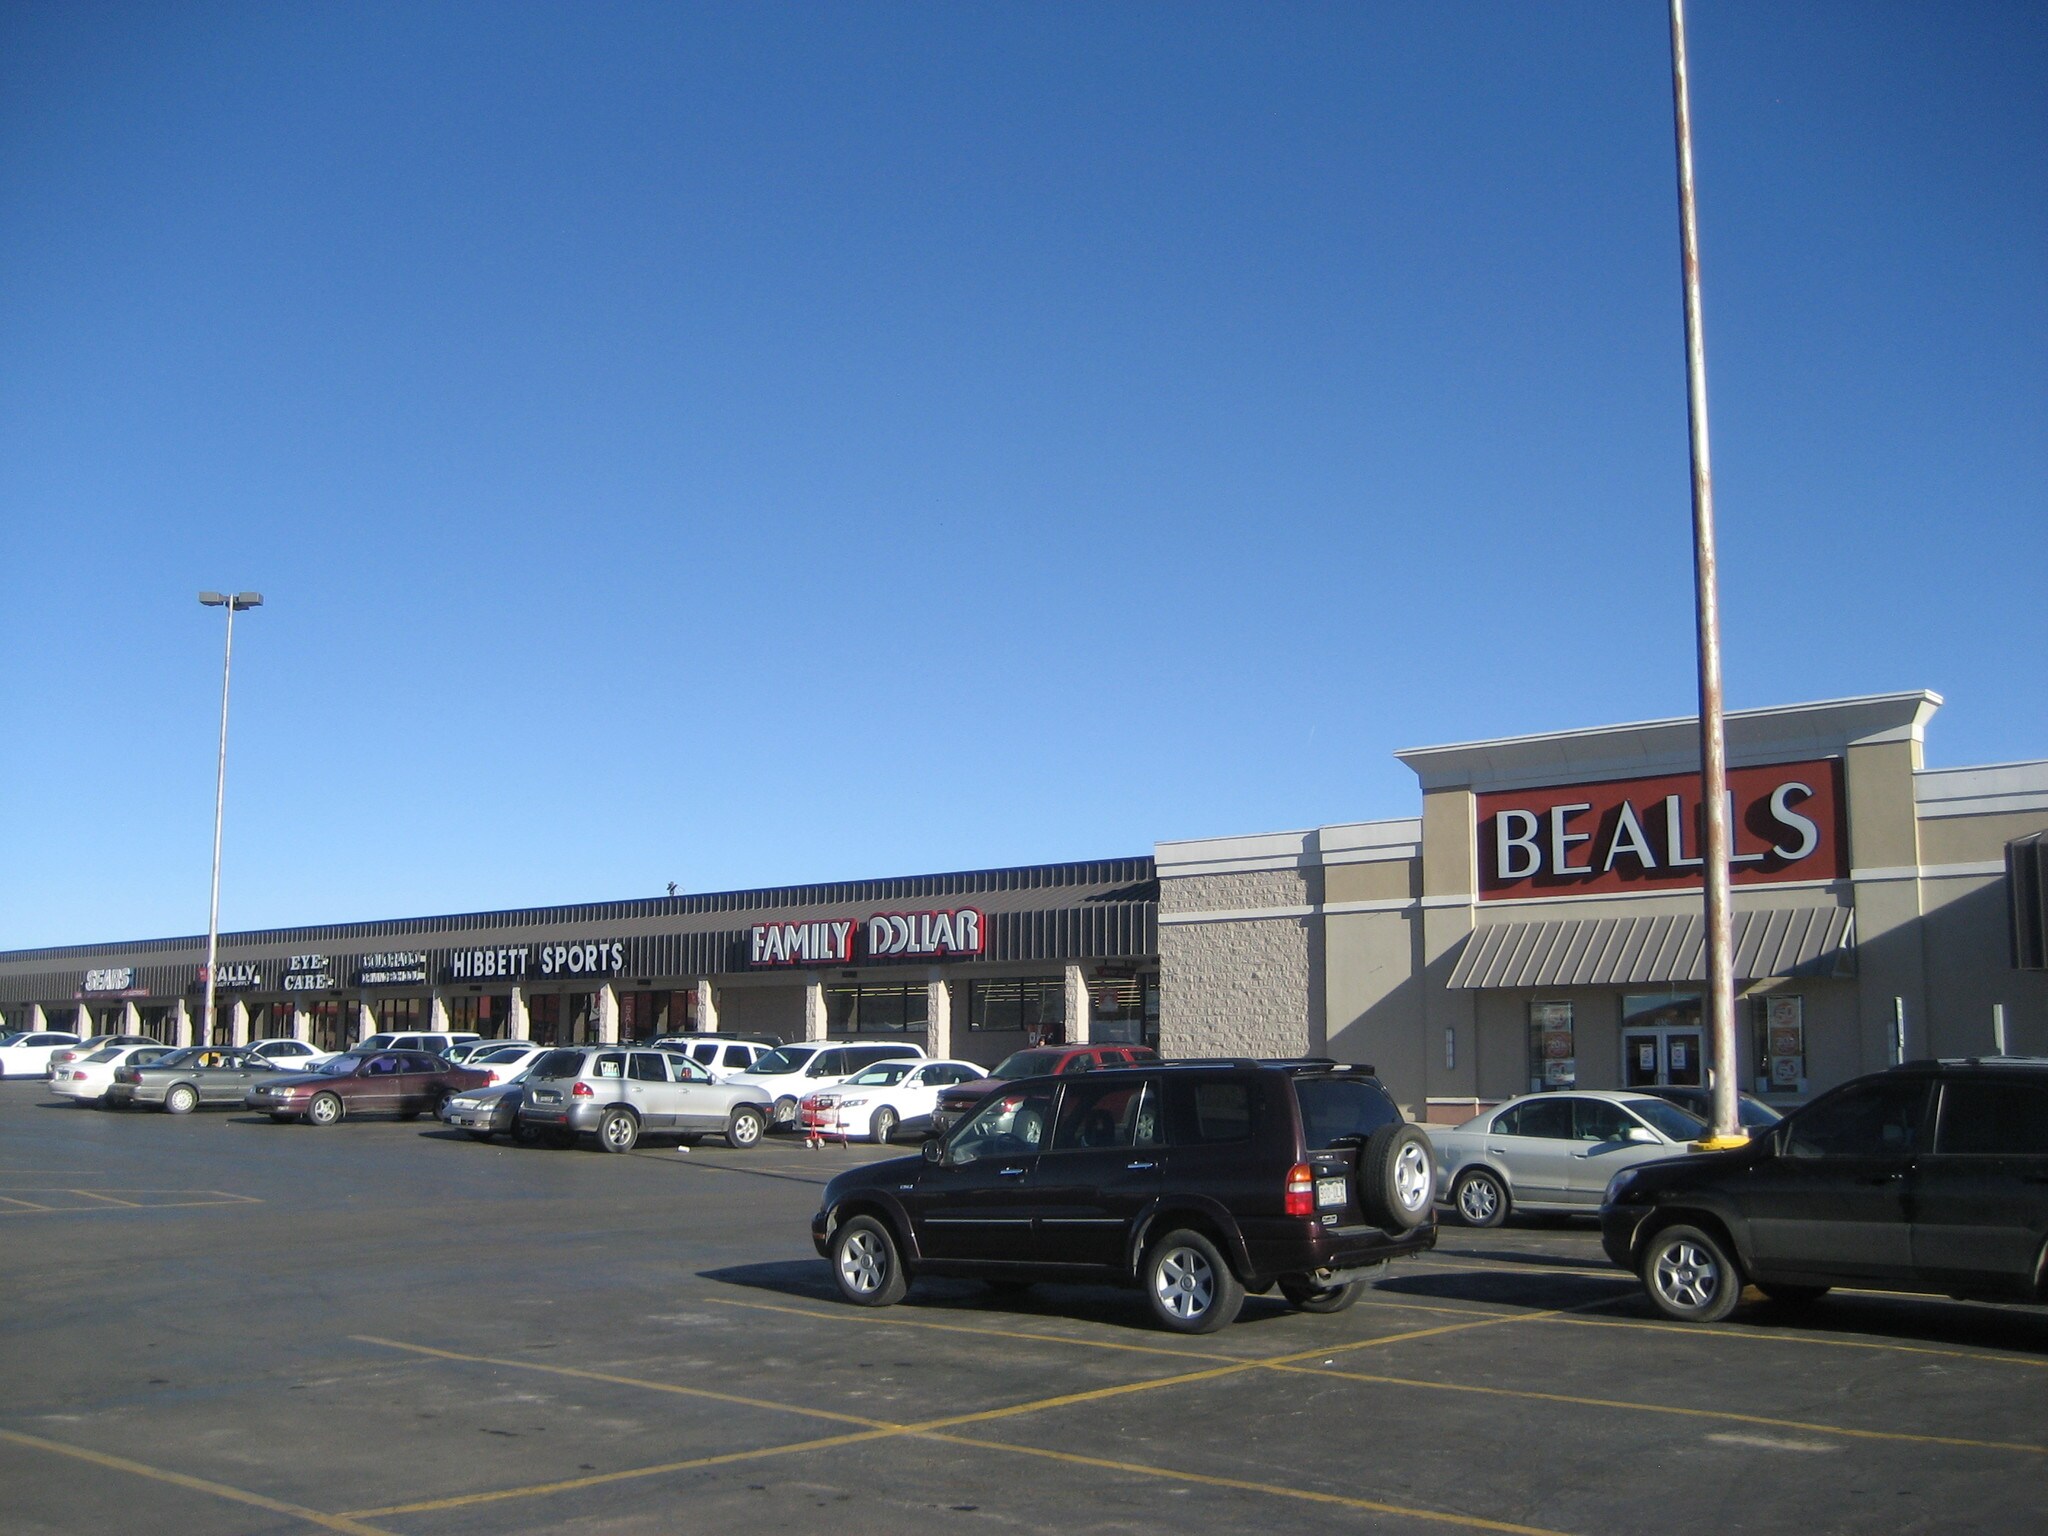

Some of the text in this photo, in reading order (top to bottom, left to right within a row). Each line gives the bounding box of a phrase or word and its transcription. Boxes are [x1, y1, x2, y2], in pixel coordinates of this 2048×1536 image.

[1495, 782, 1818, 878] BEALLS
[752, 909, 979, 962] FAMILY DOLLAR
[290, 954, 321, 971] EYE
[453, 942, 623, 978] HIBBETT SPORTS
[85, 967, 130, 991] SEARS
[214, 964, 256, 981] ALLY
[284, 974, 327, 991] CARE
